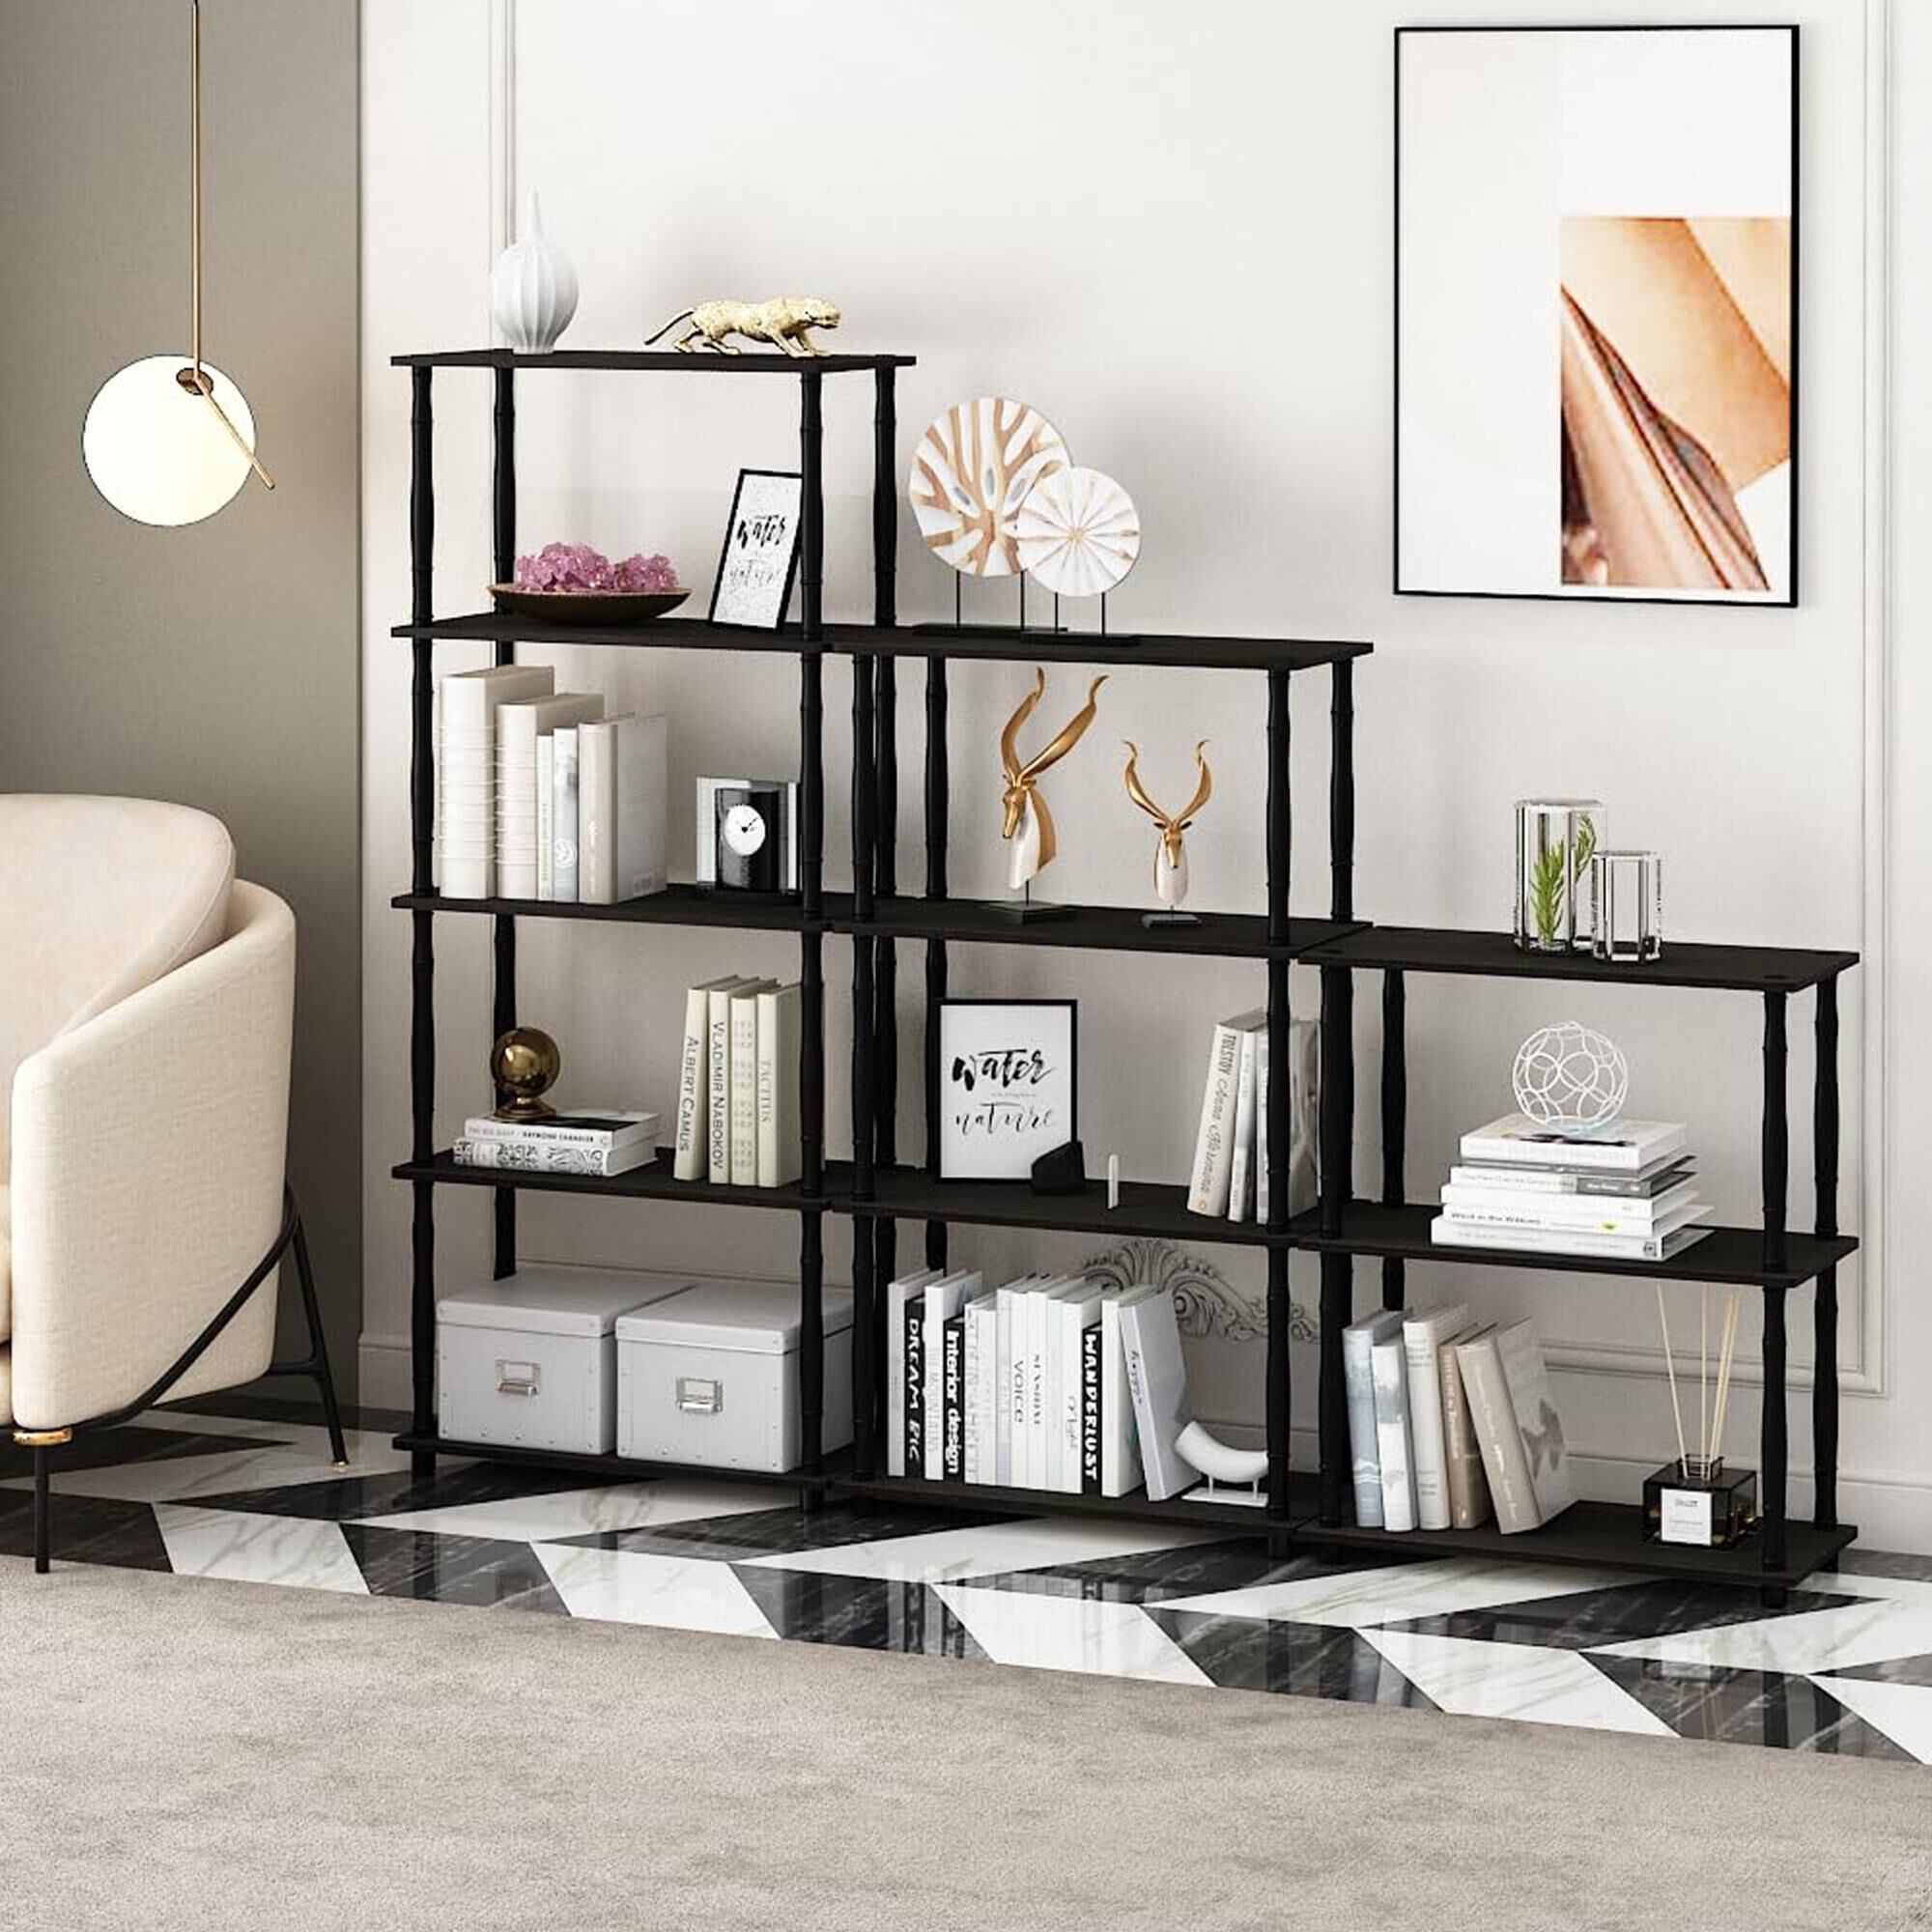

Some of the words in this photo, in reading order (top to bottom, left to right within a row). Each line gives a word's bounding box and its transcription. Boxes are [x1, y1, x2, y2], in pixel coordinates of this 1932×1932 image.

[683, 1036, 699, 1094] ALBERT
[713, 1021, 725, 1093] VLADIMIR
[952, 1049, 1056, 1092] water
[1218, 1033, 1237, 1077] TOLSTOY
[678, 1096, 695, 1152] CAMUS
[955, 1102, 1052, 1135] nature
[1211, 1077, 1229, 1122] Anna
[713, 1095, 725, 1169] NABOKOV
[909, 1318, 920, 1409] DREAM
[947, 1330, 960, 1403] Interior
[1084, 1333, 1098, 1481] WANDERLUST
[946, 1407, 962, 1474] design
